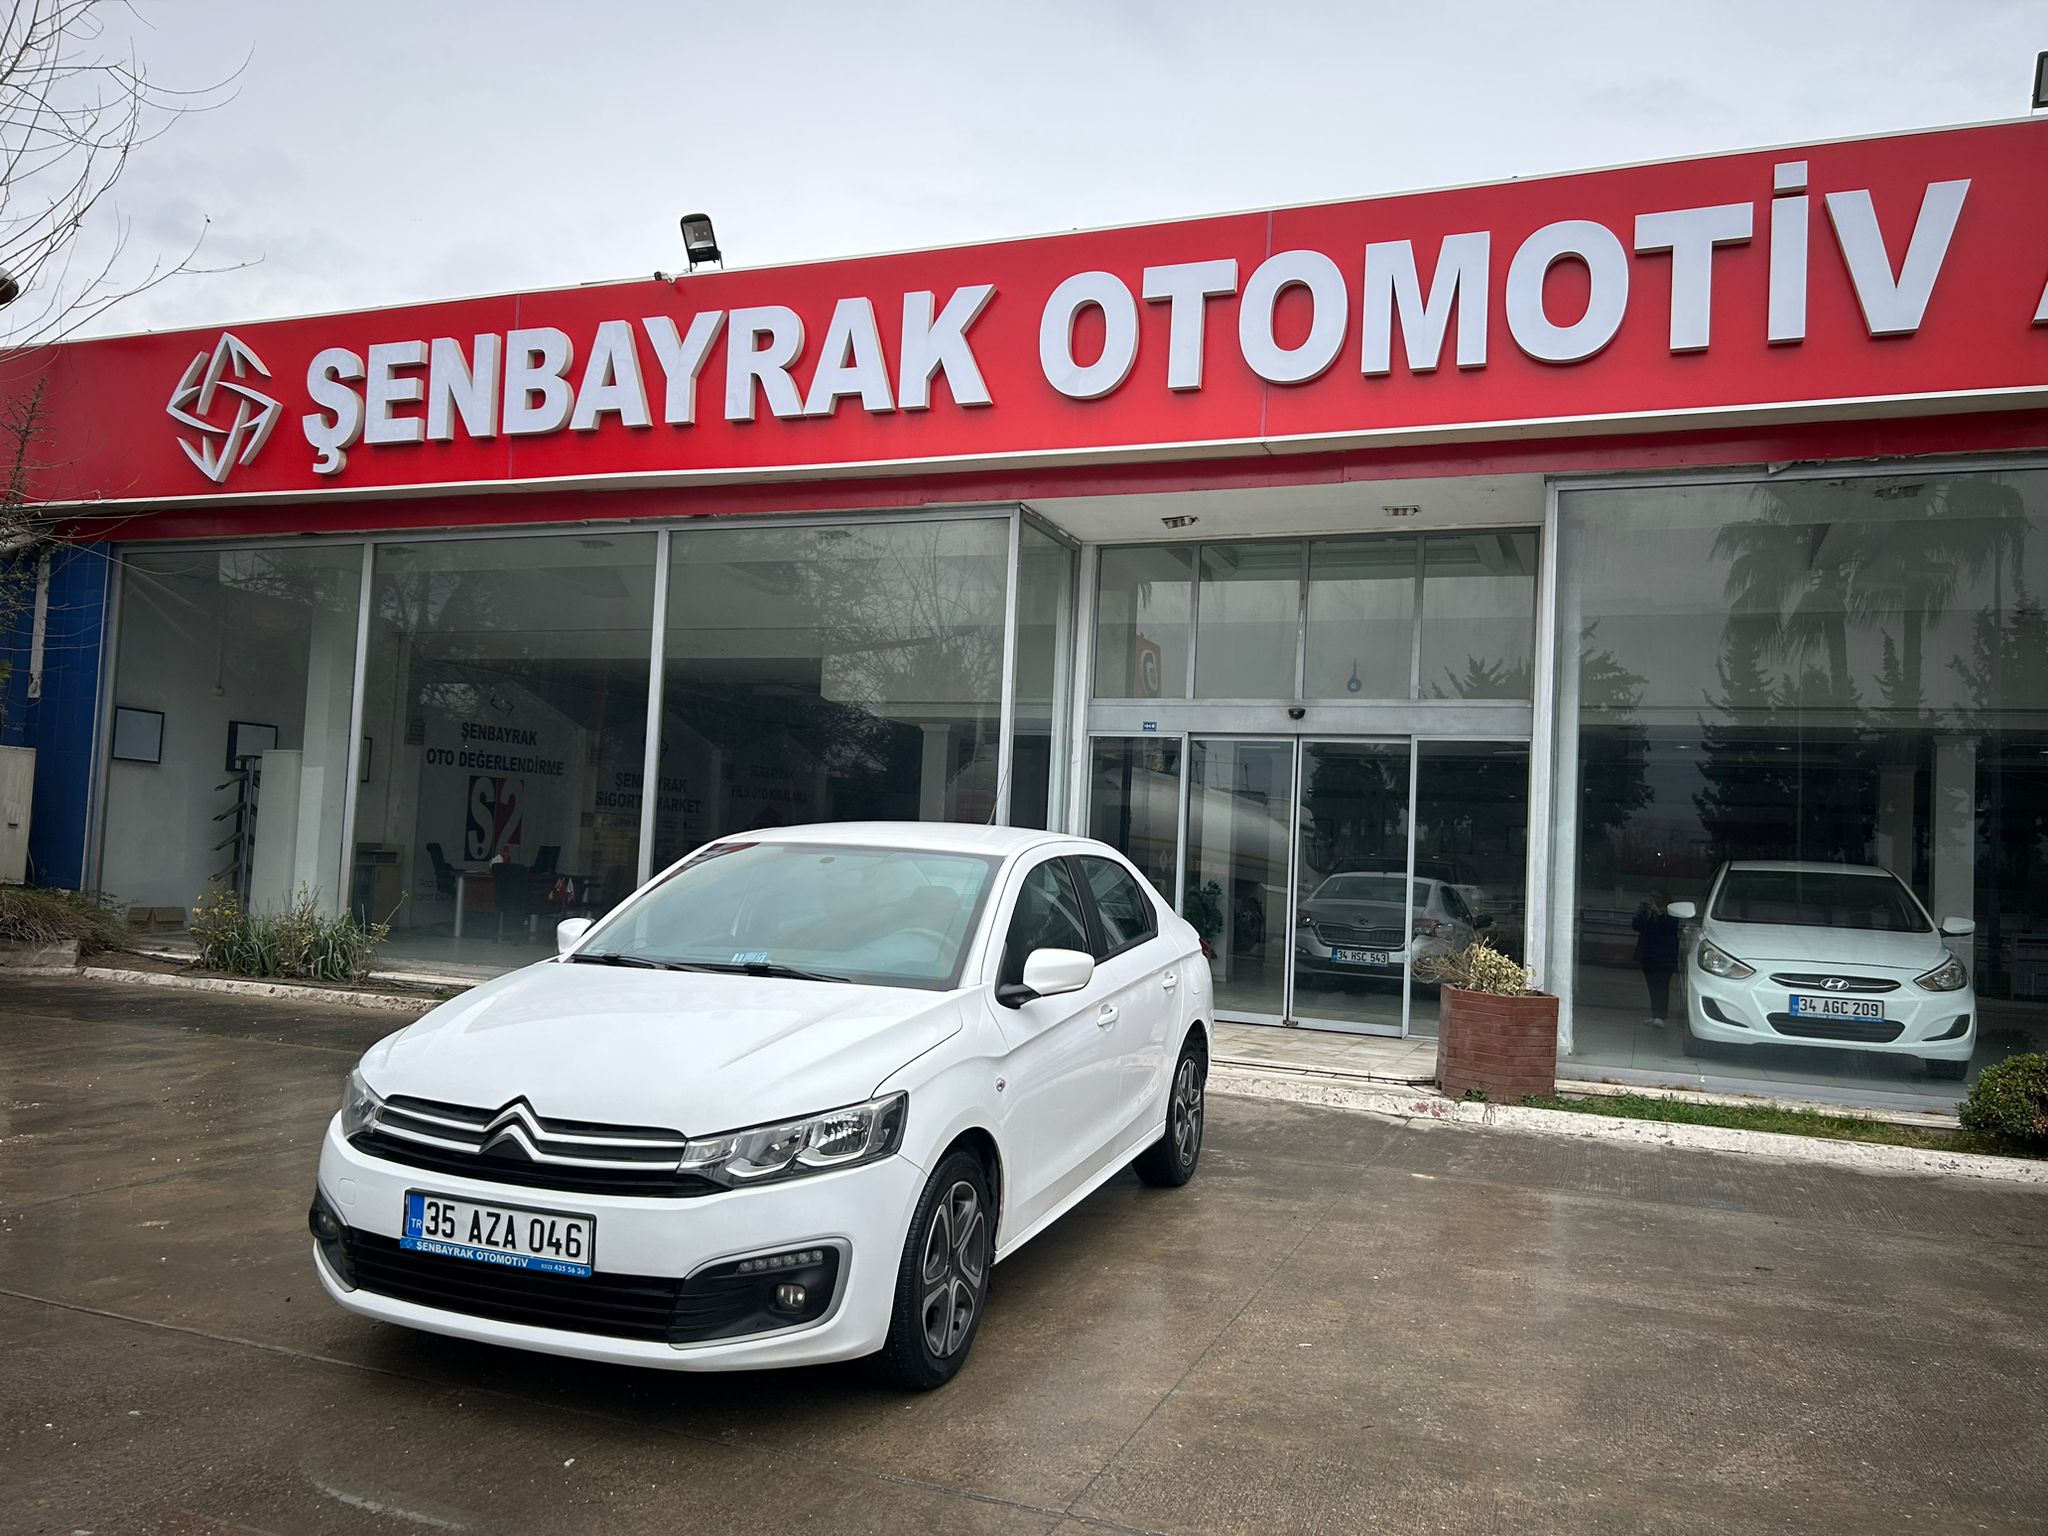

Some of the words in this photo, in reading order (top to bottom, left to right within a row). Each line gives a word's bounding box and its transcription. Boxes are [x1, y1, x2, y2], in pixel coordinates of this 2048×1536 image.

[302, 283, 997, 476] ŞENBAYRAK
[1039, 160, 1971, 400] OTOMOTİV
[461, 722, 538, 746] ŞENBAYRAK
[426, 748, 456, 766] OTO
[459, 750, 564, 776] DEĞERLENDİRME
[1338, 950, 1348, 960] 34
[1351, 951, 1367, 962] HSC
[1370, 953, 1386, 963] 543
[1800, 998, 1816, 1012] 34
[1823, 1000, 1849, 1014] AGC
[1852, 1002, 1879, 1017] 209
[411, 1217, 422, 1230] TR
[425, 1201, 456, 1238] 35
[468, 1209, 517, 1250] AZA
[529, 1218, 582, 1258] 046
